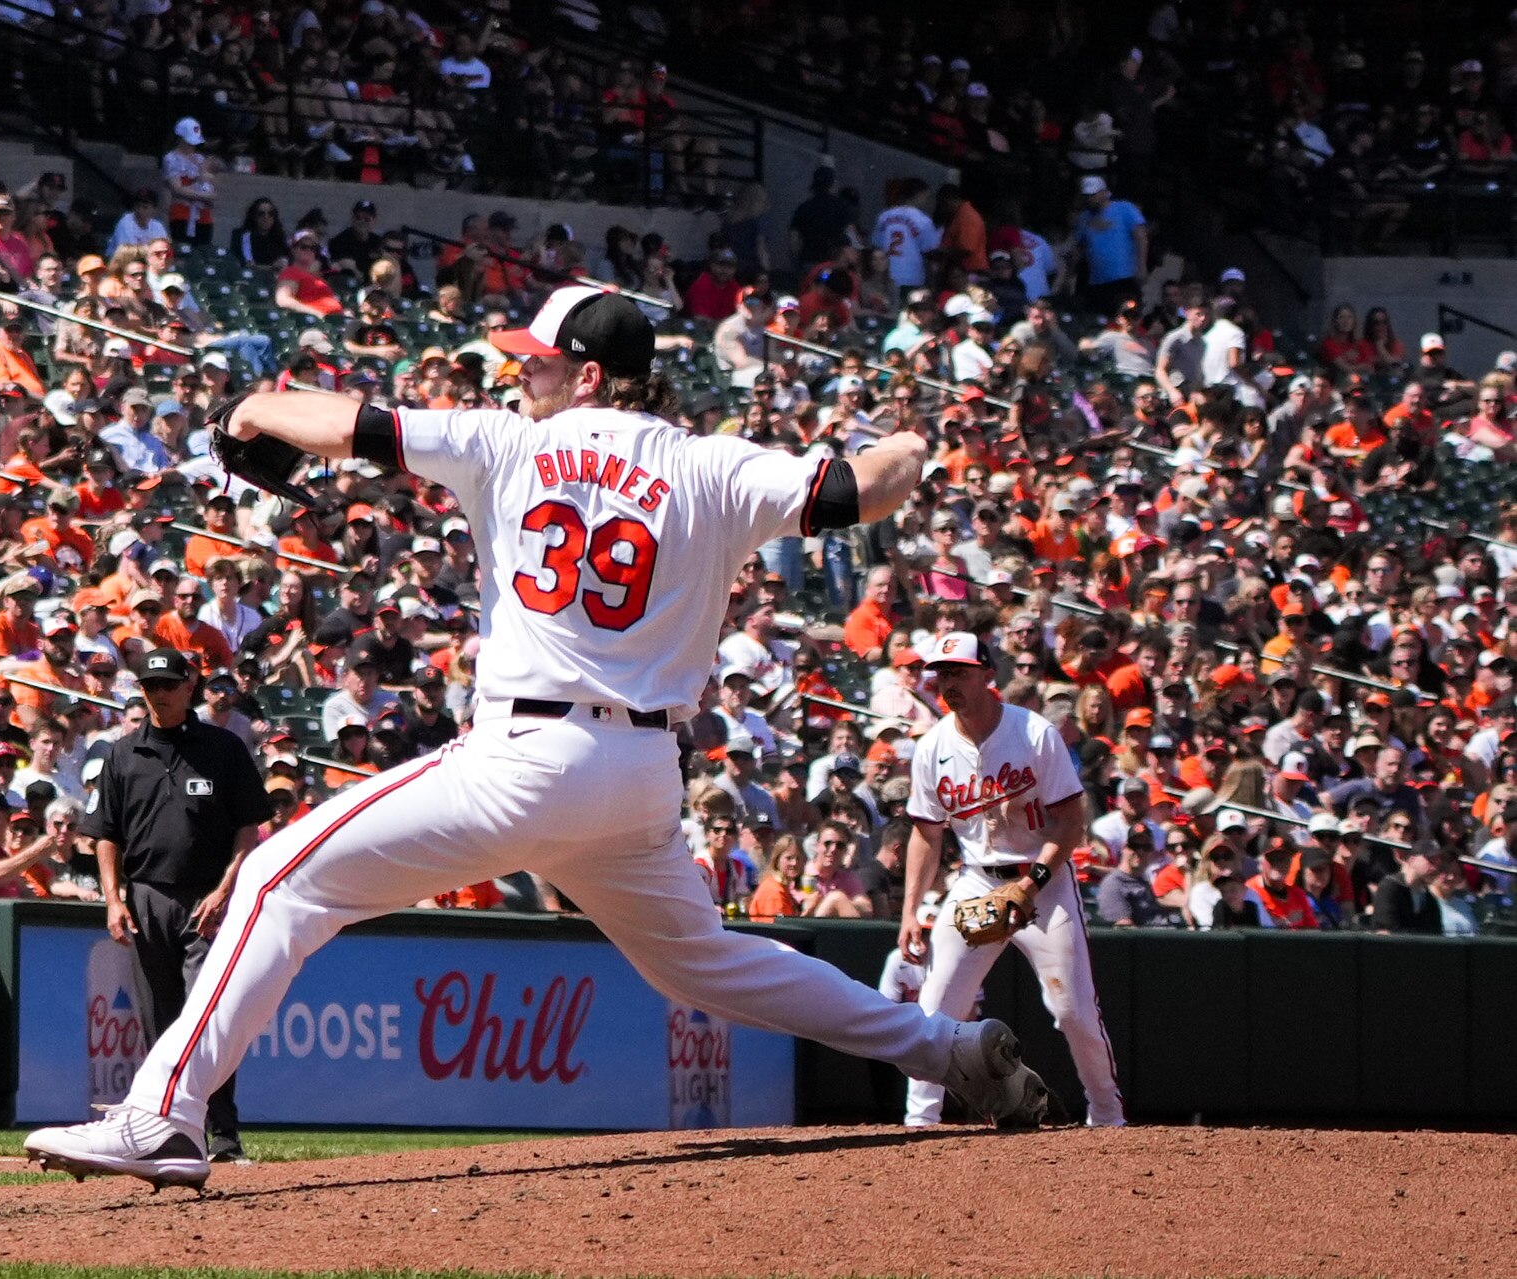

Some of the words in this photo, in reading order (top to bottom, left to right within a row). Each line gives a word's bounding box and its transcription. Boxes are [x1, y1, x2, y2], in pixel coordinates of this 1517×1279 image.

[534, 449, 670, 512] BURNES
[512, 500, 659, 632] 39
[937, 762, 1037, 816] Orioles
[1024, 798, 1045, 830] 11
[251, 1002, 402, 1060] HOOSE
[414, 971, 594, 1084] Chill
